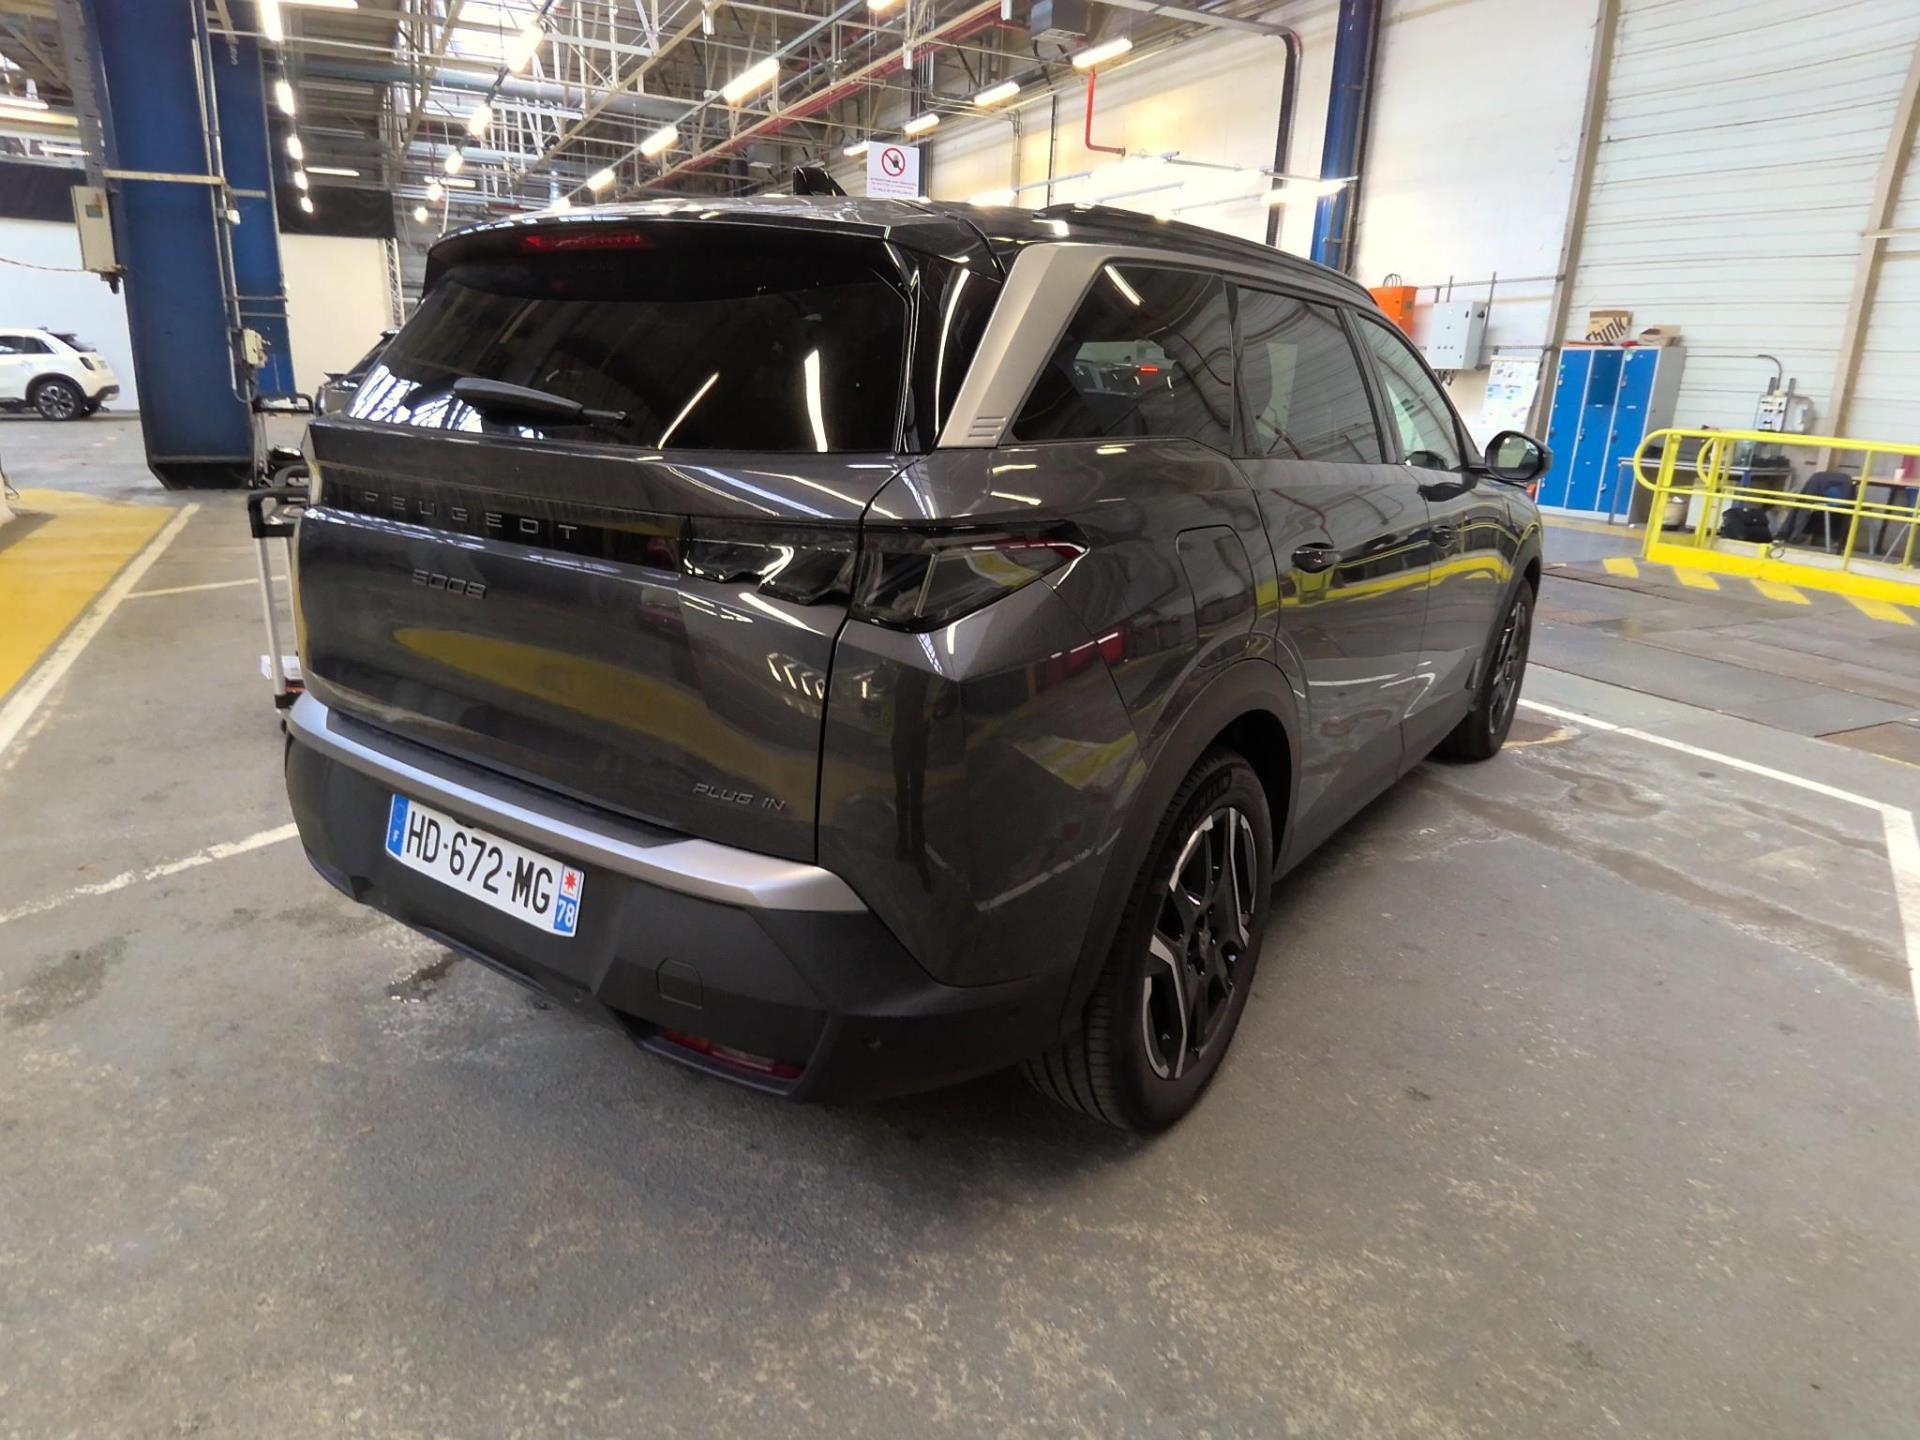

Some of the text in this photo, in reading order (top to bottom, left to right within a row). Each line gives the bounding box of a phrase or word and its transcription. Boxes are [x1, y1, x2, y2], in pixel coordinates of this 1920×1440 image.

[363, 491, 578, 540] PEUGEOT
[412, 568, 487, 600] 5008
[692, 782, 786, 811] PLUG IN
[392, 828, 401, 844] F
[406, 810, 554, 915] HD-672-MG
[557, 898, 576, 928] 78
